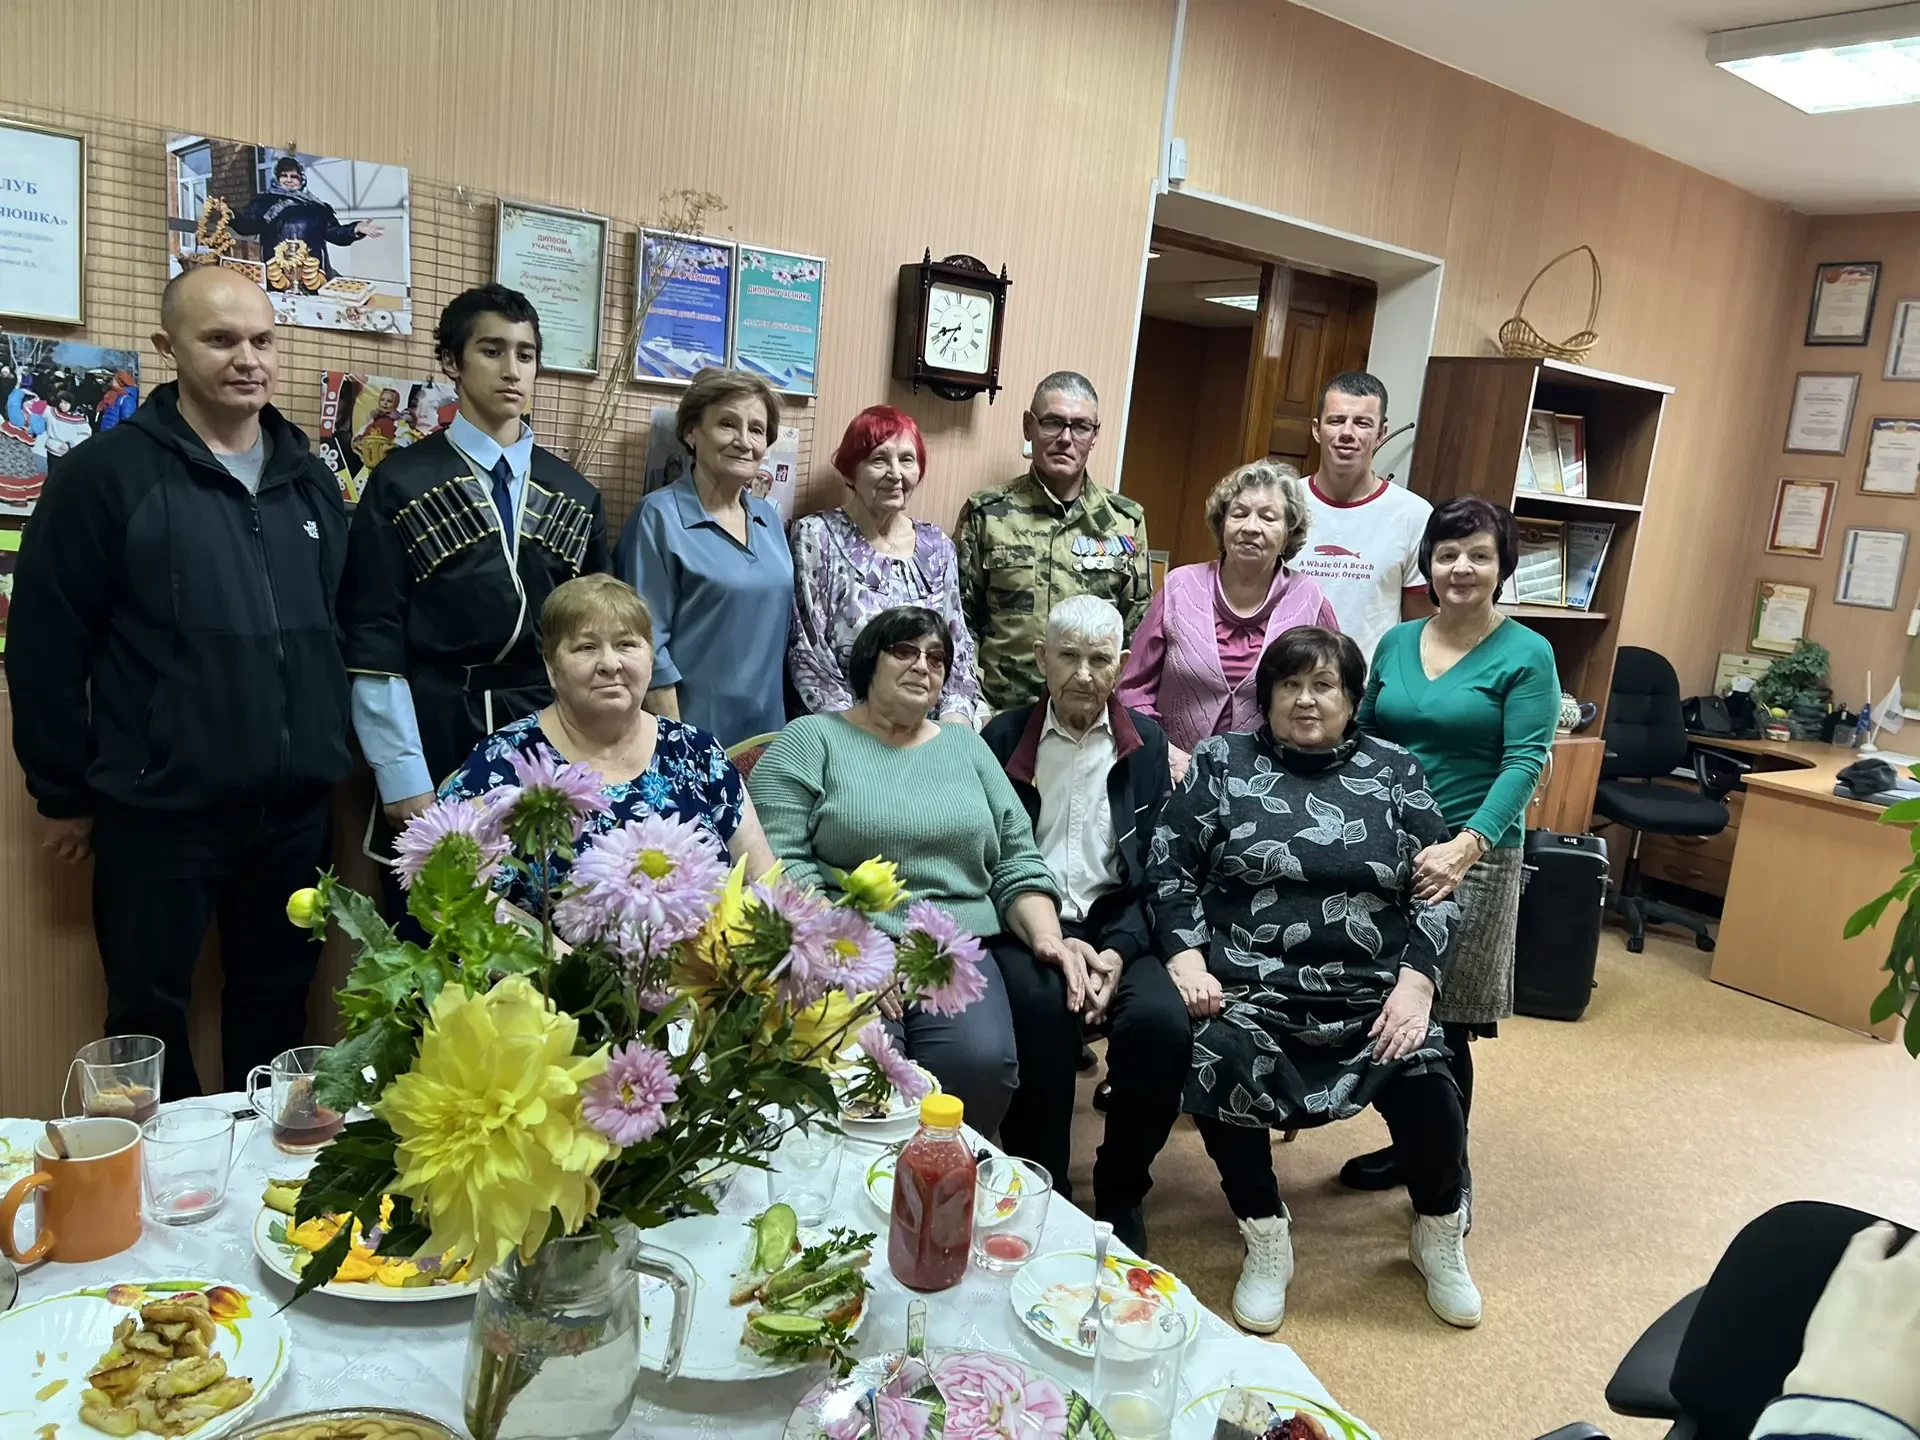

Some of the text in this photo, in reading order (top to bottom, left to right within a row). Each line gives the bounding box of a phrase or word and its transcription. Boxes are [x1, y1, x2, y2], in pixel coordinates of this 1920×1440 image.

[537, 234, 567, 245] ДИПЛОМ
[531, 242, 572, 254] УЧАСТНИКА
[1306, 560, 1331, 568] Whale
[1342, 571, 1371, 580] Oregon
